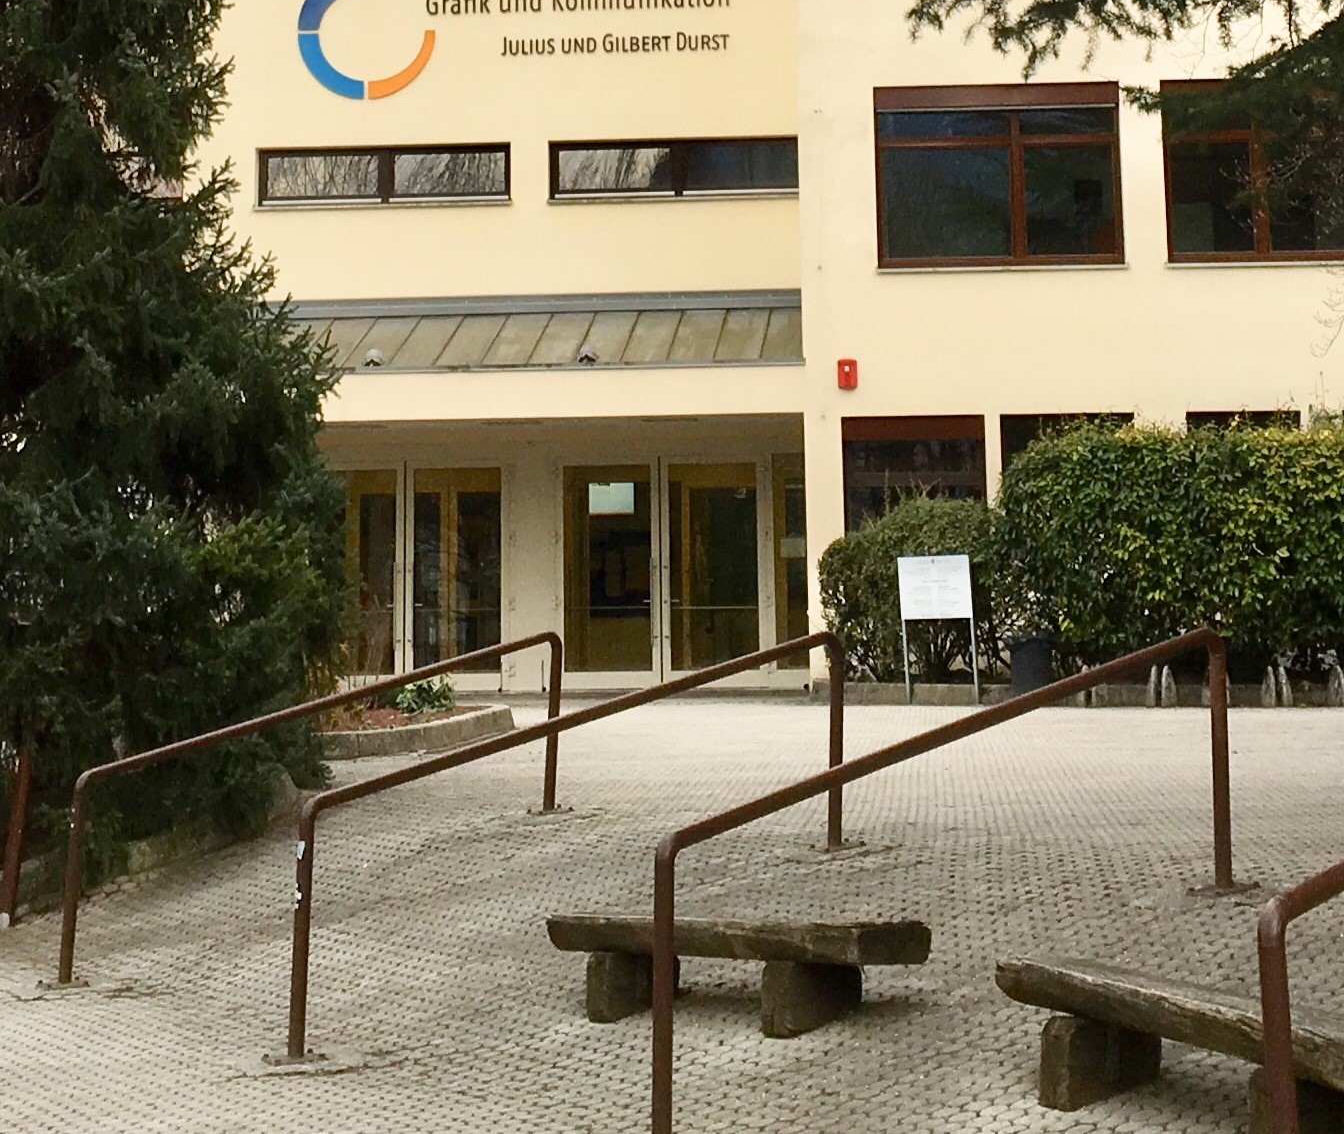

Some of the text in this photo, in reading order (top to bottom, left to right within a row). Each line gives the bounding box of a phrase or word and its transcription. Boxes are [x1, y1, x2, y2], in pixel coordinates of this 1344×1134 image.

[501, 36, 556, 57] JULIUS
[602, 33, 672, 54] GILBERT
[676, 31, 730, 52] DURST
